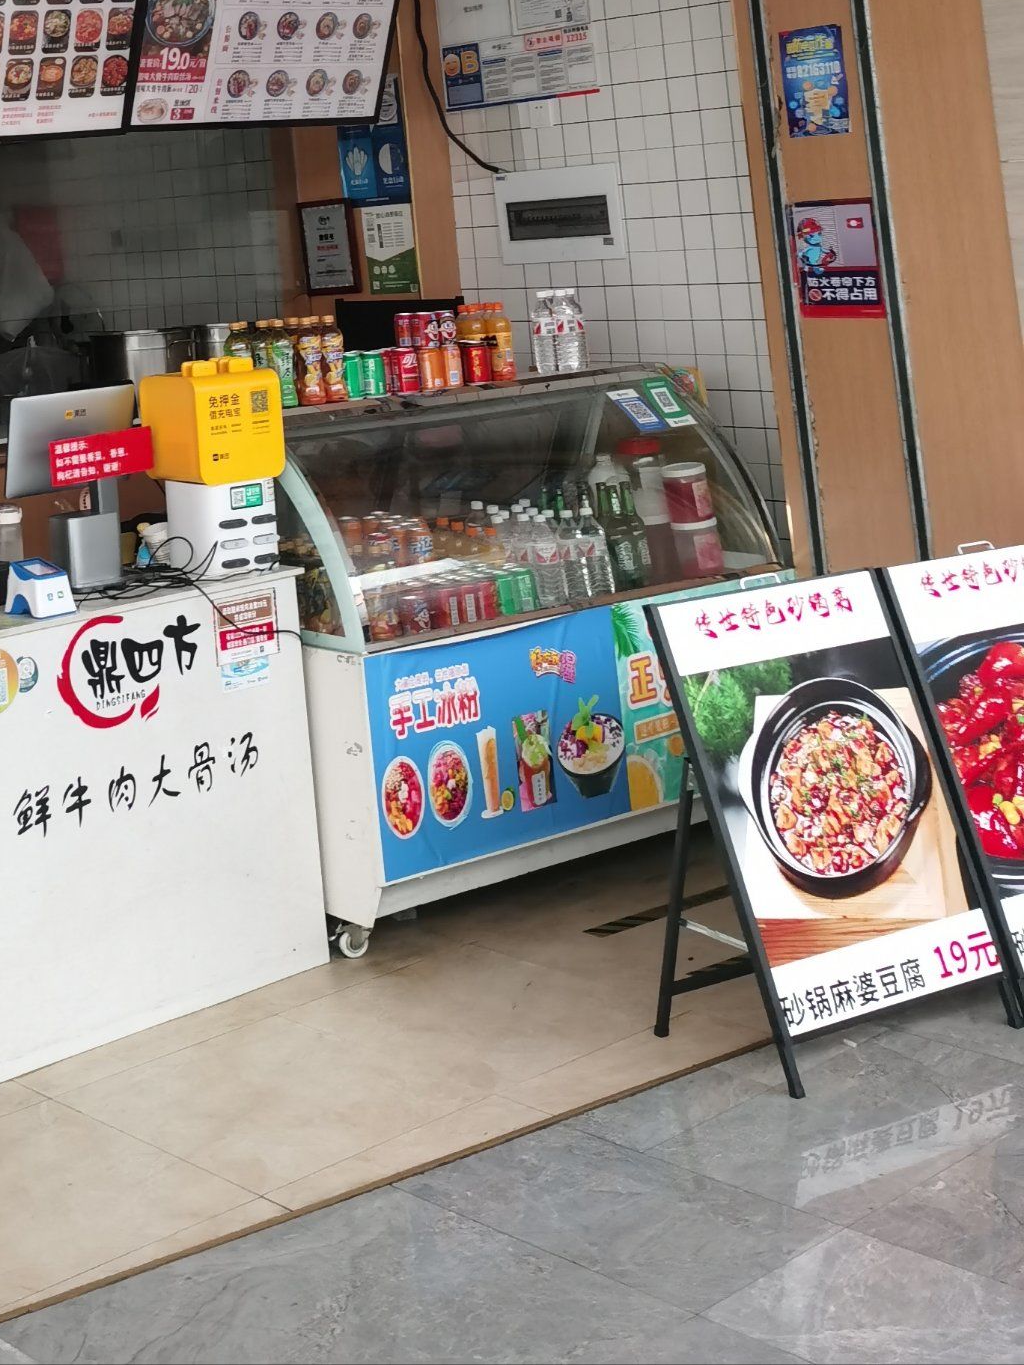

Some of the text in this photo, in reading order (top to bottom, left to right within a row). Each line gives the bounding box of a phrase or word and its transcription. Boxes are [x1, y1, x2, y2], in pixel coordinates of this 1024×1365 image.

[822, 287, 878, 301] 不得占用
[209, 393, 241, 409] 免押金
[82, 614, 201, 697] 鼎四方
[388, 676, 481, 740] 手工冰粉
[12, 730, 261, 837] 鲜牛肉大骨汤
[777, 930, 1002, 1028] 砂锅麻婆豆腐 19元
